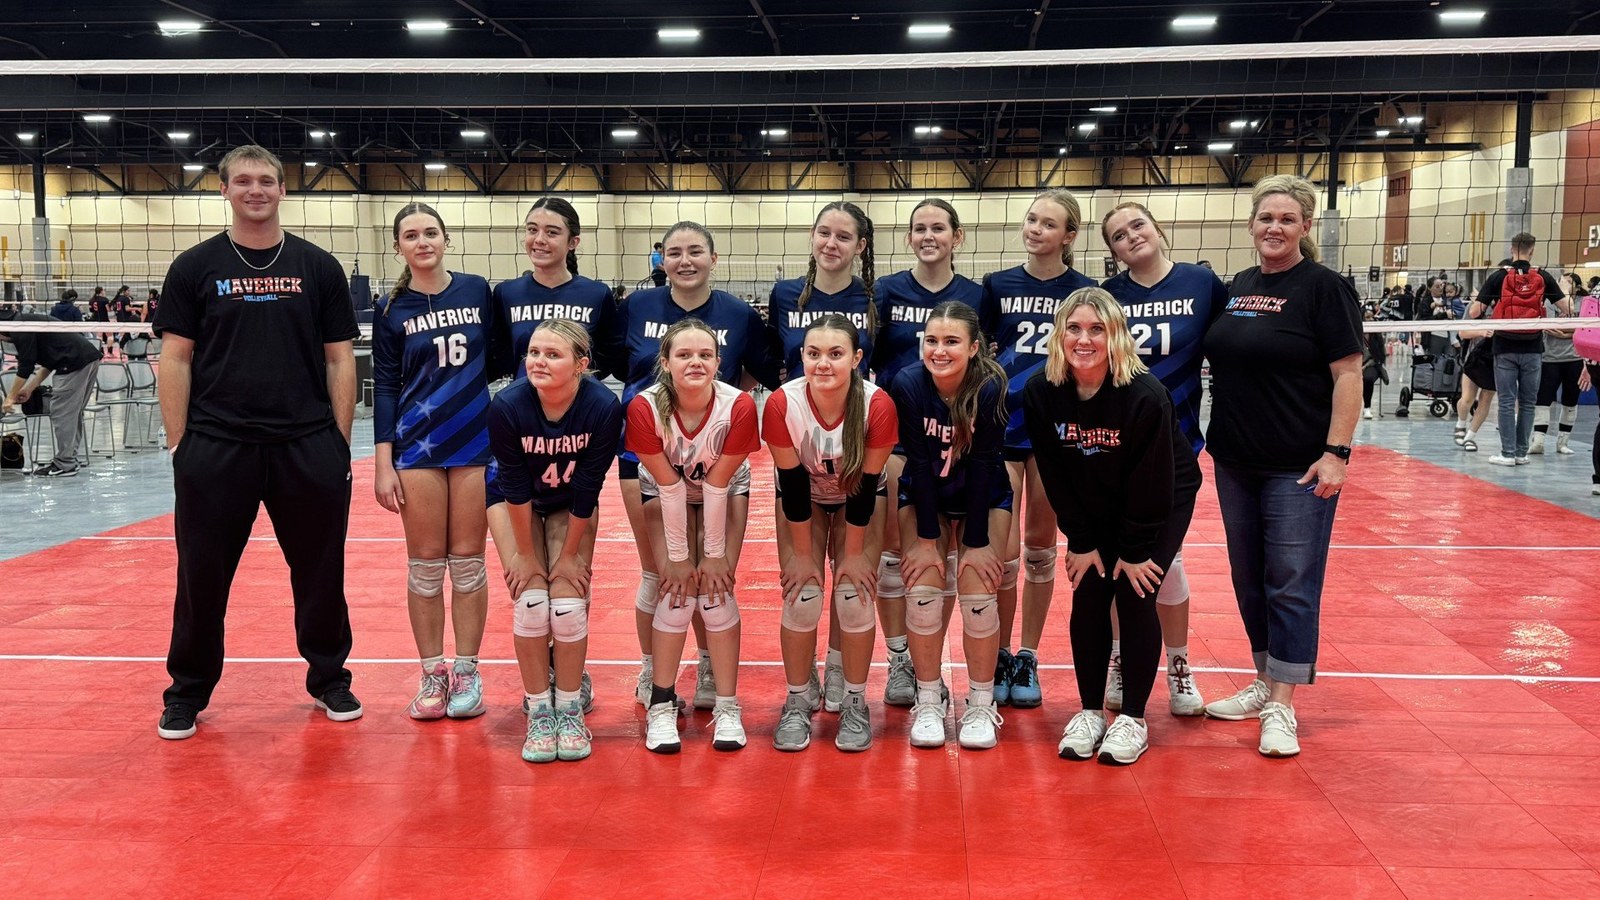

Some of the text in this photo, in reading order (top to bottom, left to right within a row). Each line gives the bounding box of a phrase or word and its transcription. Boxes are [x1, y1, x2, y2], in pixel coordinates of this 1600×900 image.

[1393, 245, 1408, 262] EXIT
[215, 277, 303, 296] MAVERICK
[509, 303, 594, 323] MAVERICK
[1000, 296, 1061, 315] MAVERI
[1123, 298, 1195, 318] AVERICK
[1225, 295, 1288, 313] MAVERICK
[402, 306, 482, 336] MAVERICK
[1015, 320, 1055, 355] 22
[1130, 321, 1170, 355] 21
[432, 332, 468, 368] 16
